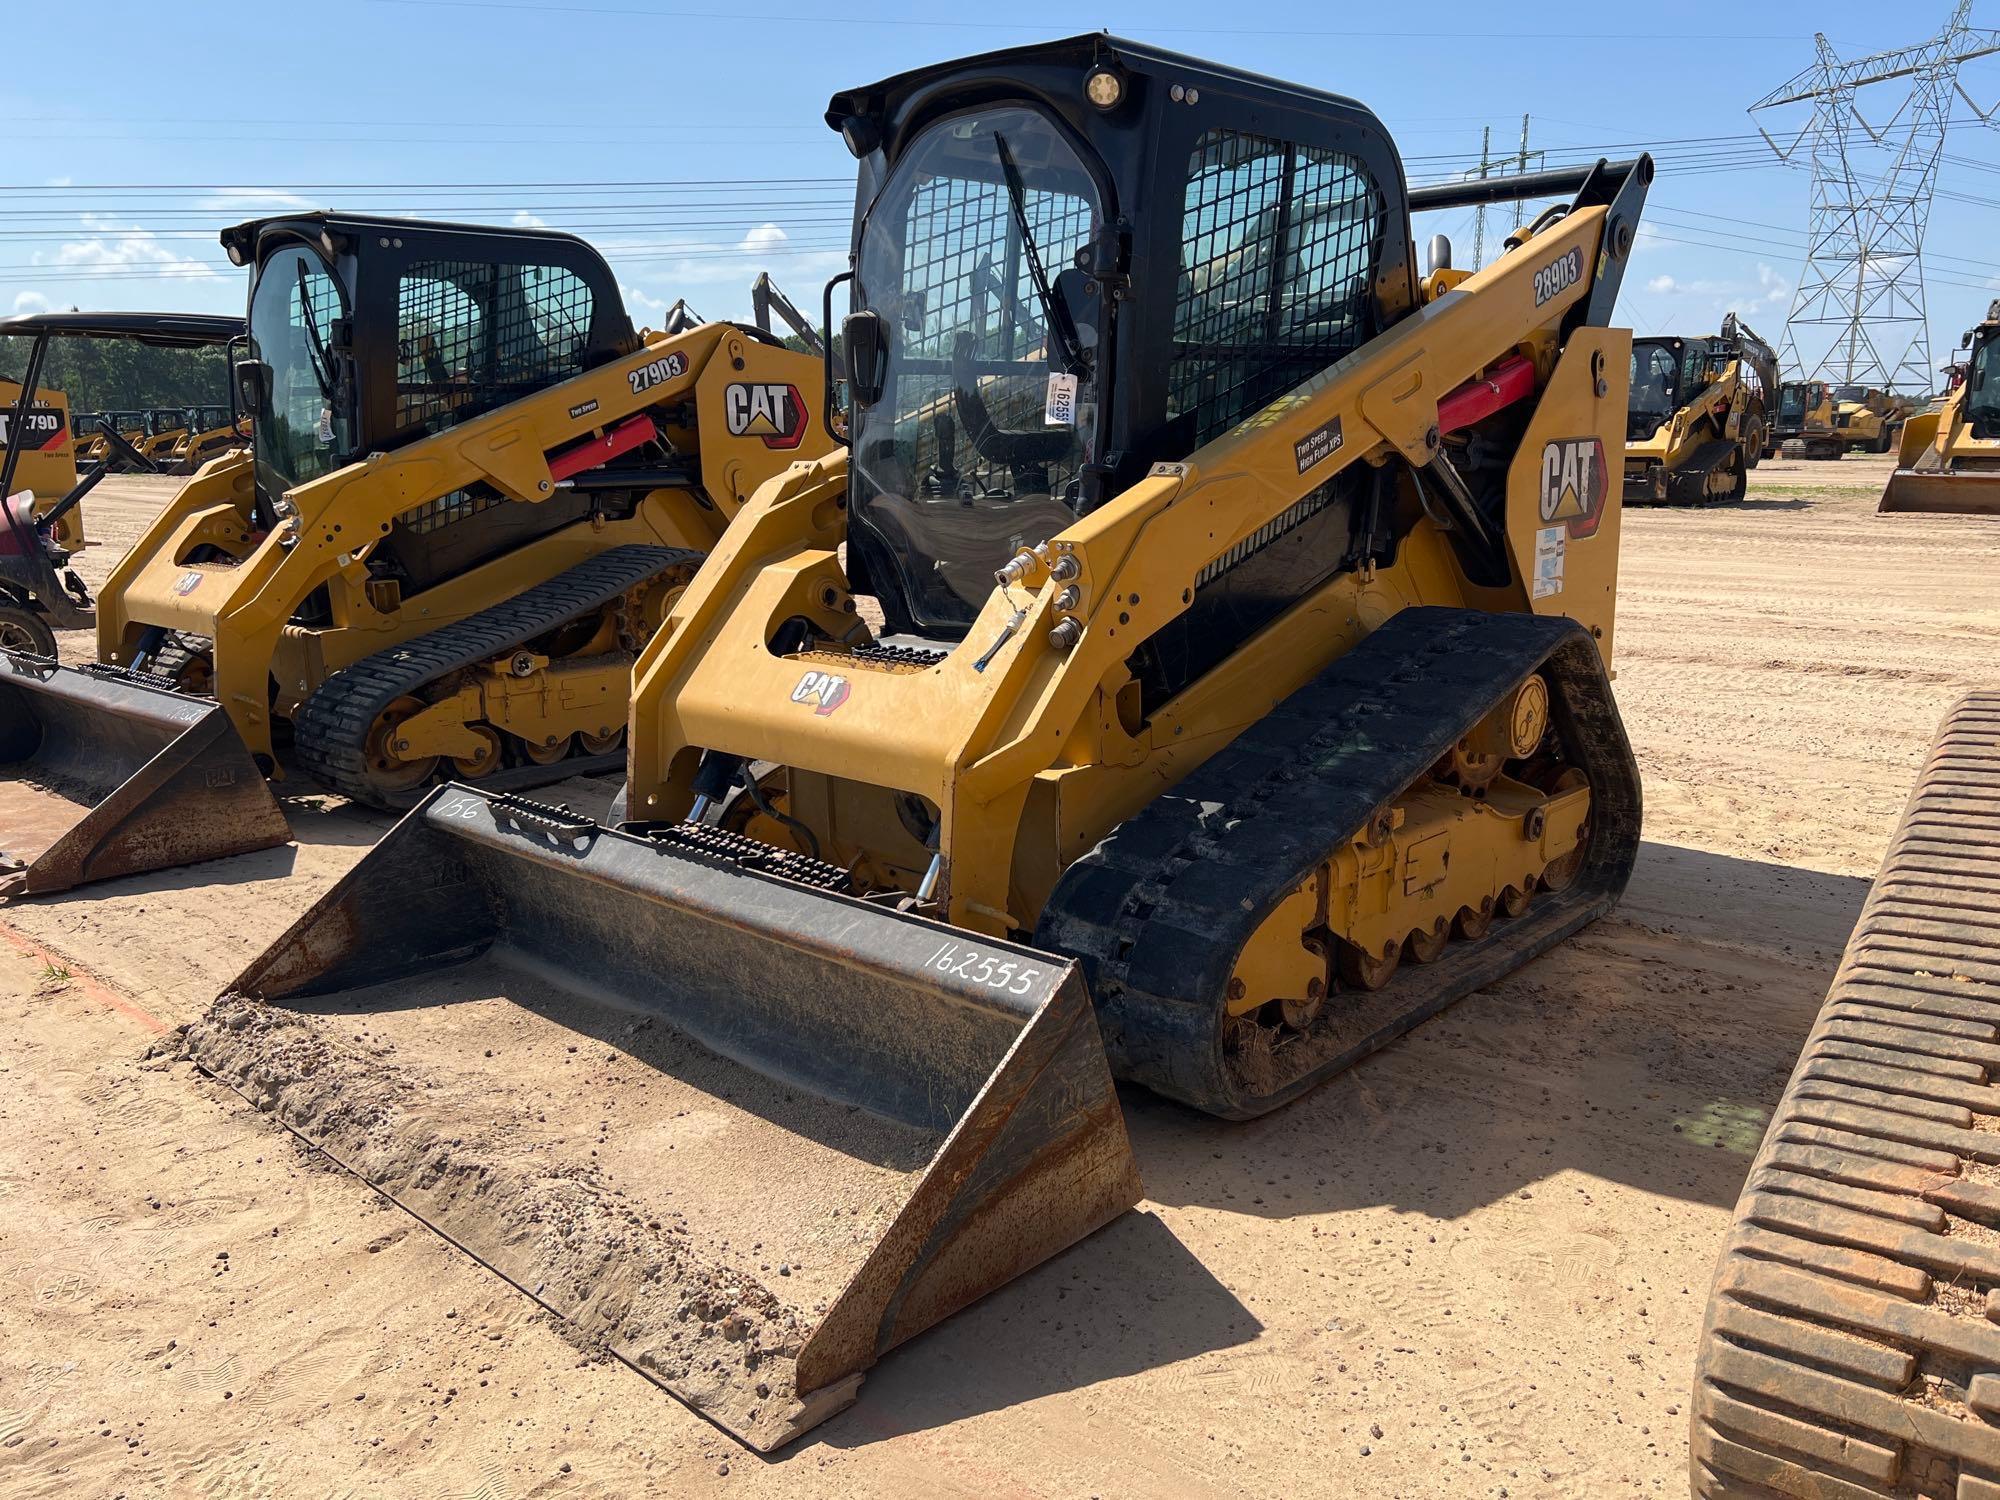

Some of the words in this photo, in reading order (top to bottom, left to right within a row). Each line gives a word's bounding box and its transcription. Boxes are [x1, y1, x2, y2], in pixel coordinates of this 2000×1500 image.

[1534, 252, 1577, 308] 289D3
[628, 354, 682, 395] 279D3
[726, 384, 788, 435] CAT
[1297, 442, 1310, 458] TWO
[1310, 430, 1328, 449] SPEED
[1300, 454, 1314, 471] HIGH
[1314, 443, 1329, 461] FLOW
[1329, 433, 1341, 450] XPS
[1541, 441, 1595, 521] CAT
[791, 671, 844, 706] CAT
[434, 797, 482, 819] 156
[924, 942, 1040, 995] 162555
